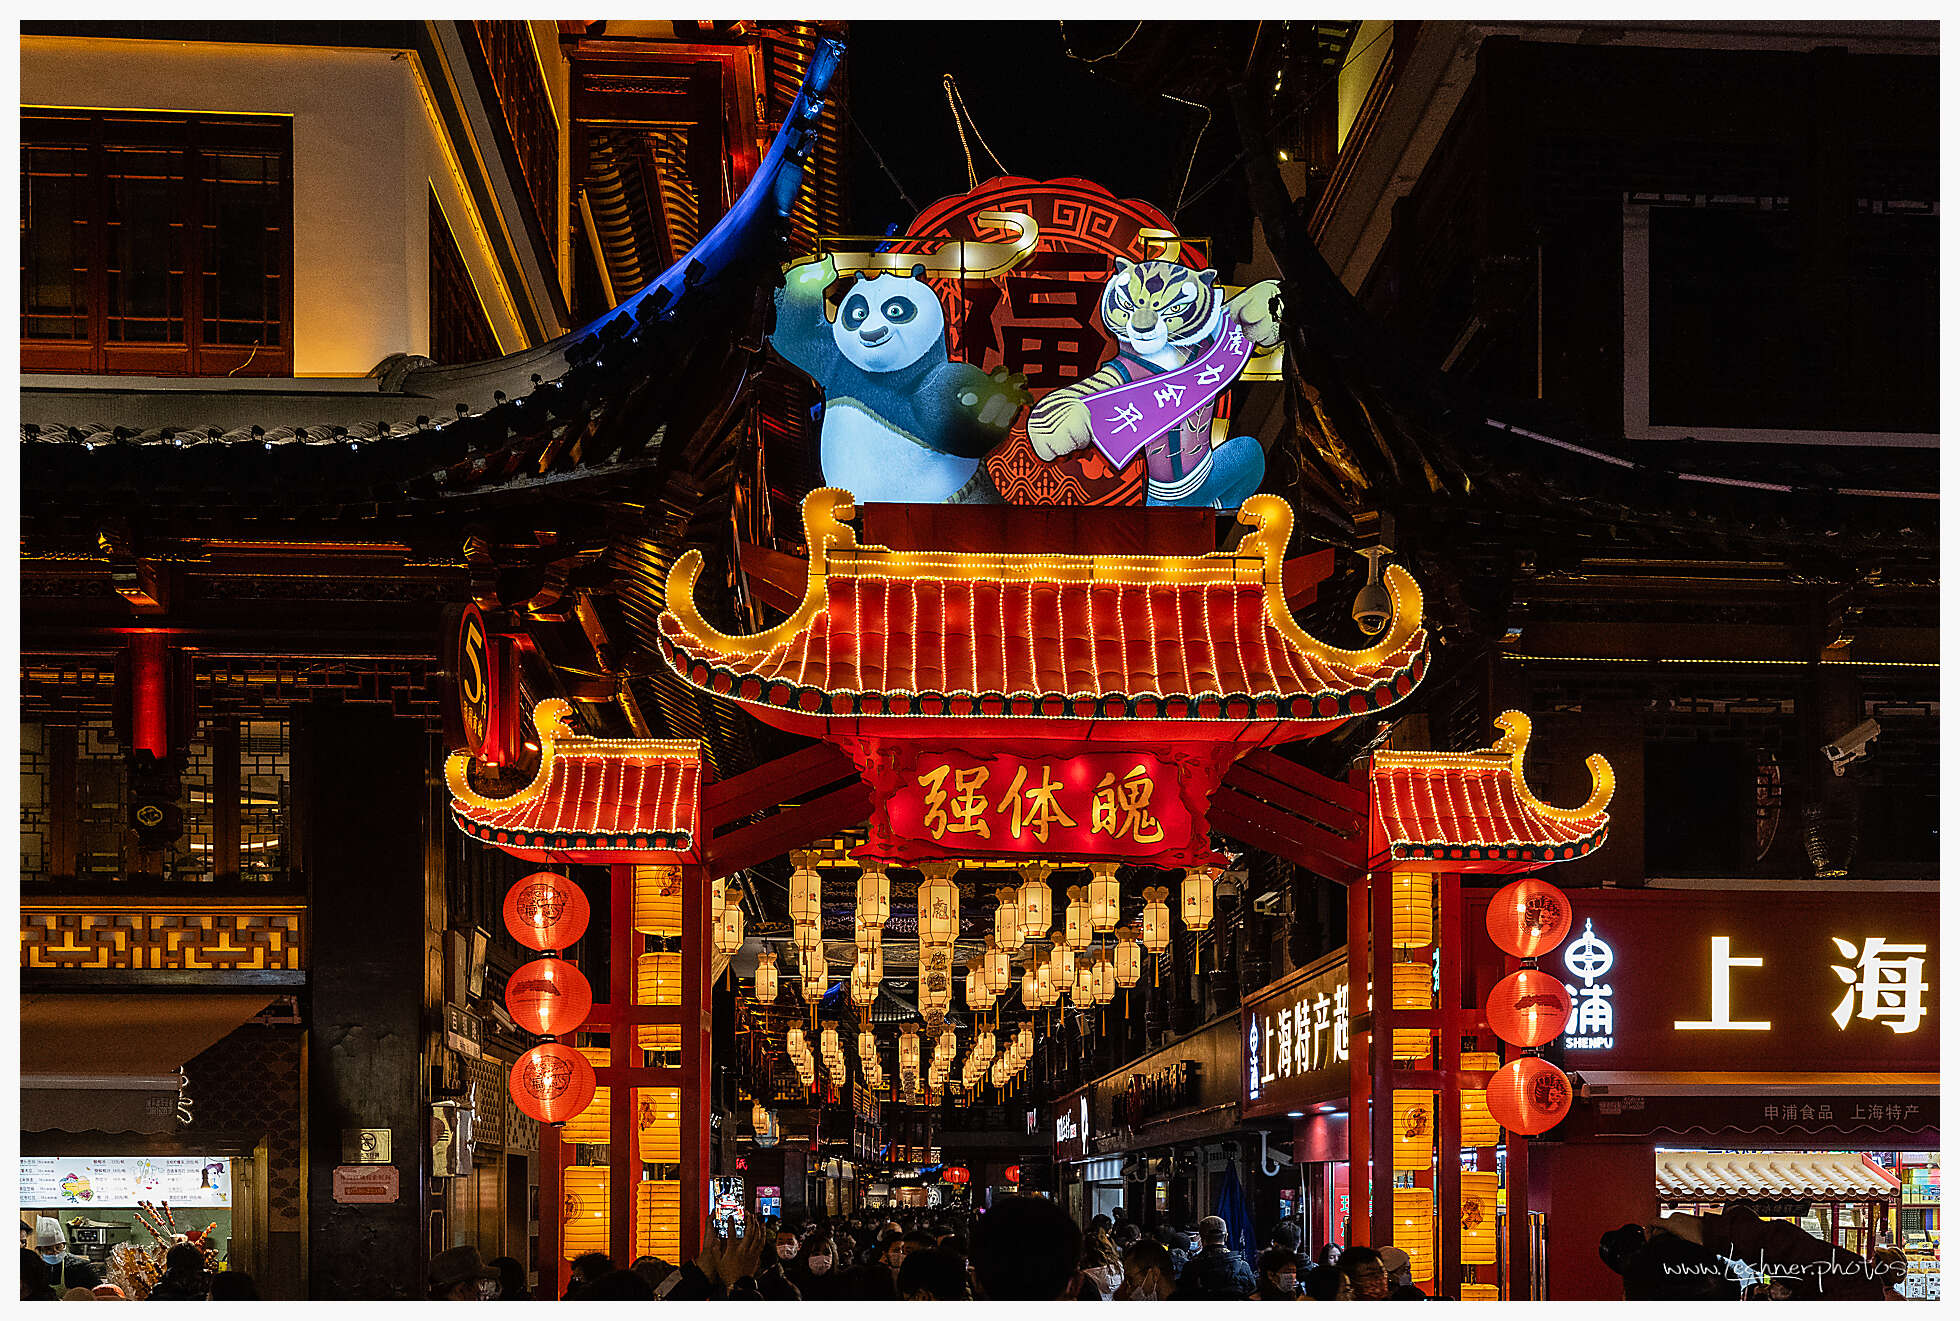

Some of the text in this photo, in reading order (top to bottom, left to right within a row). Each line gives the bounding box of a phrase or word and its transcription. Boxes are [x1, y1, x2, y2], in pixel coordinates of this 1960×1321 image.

[464, 621, 483, 703] 5
[917, 764, 1164, 844] 强体魄
[1673, 935, 1930, 1034] 上海
[1260, 982, 1372, 1085] 上海特产超
[1565, 1036, 1614, 1049] SHENPU
[1764, 1104, 1920, 1121] 申浦食品 上海特产
